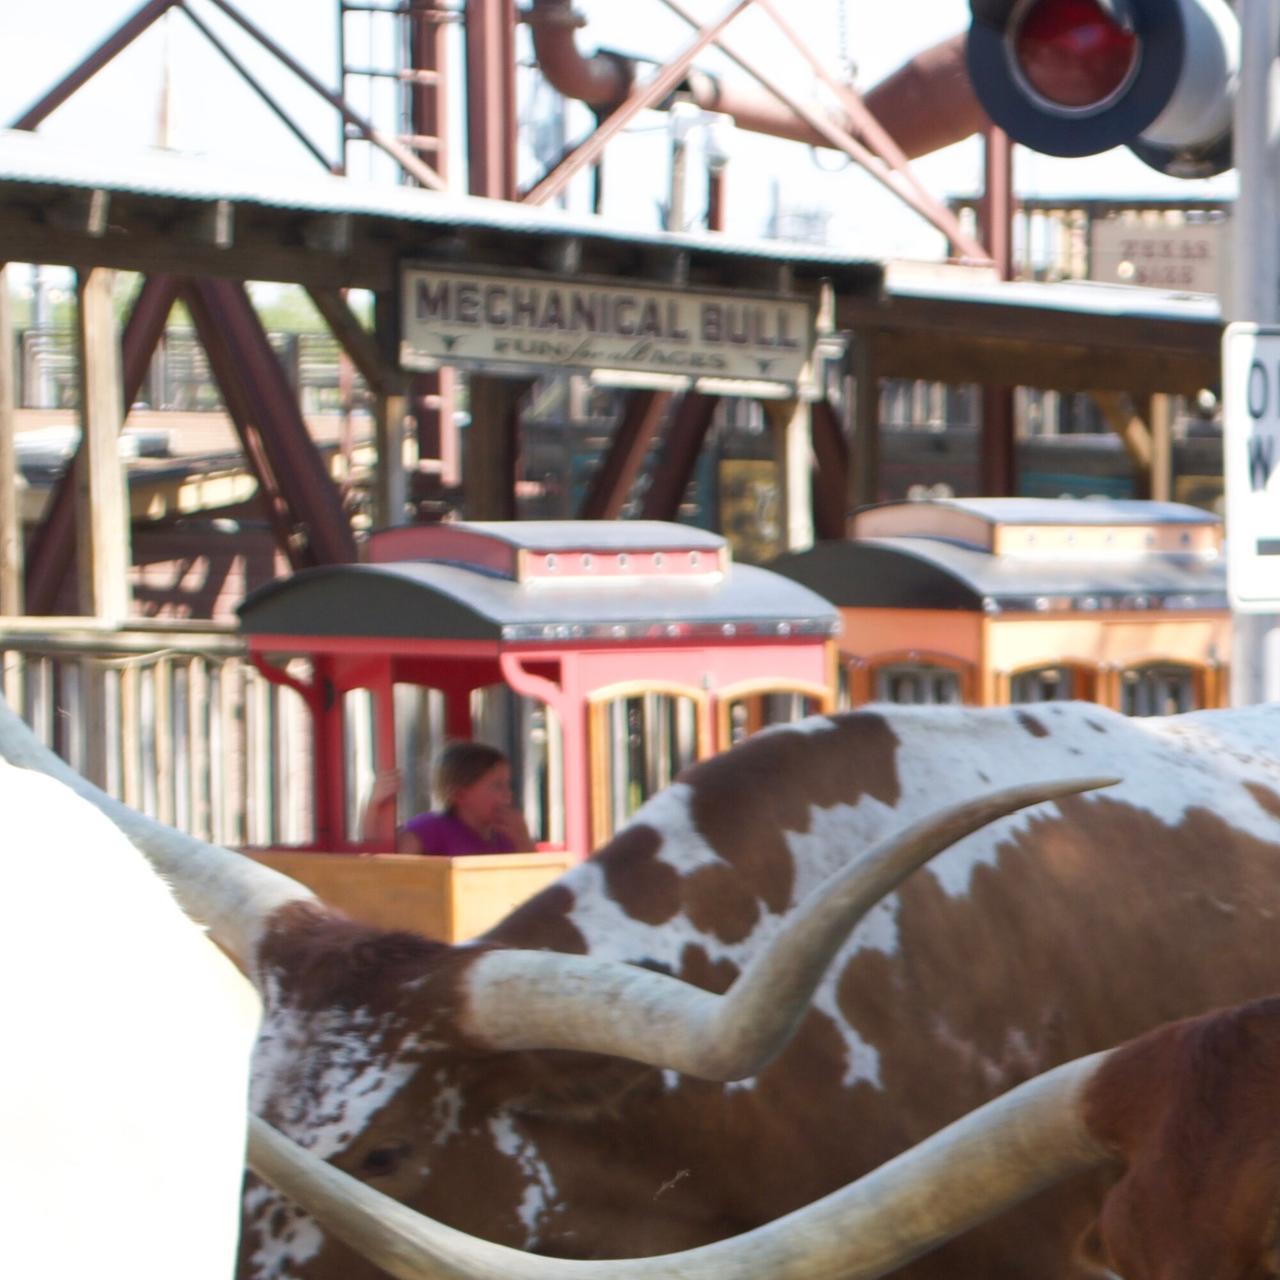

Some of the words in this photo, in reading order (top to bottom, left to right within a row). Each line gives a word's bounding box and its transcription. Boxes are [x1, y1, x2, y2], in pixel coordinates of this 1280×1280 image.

[414, 278, 690, 340] MECHANICAL
[702, 302, 801, 349] BULL
[494, 336, 565, 358] FUN
[654, 350, 727, 369] AGES
